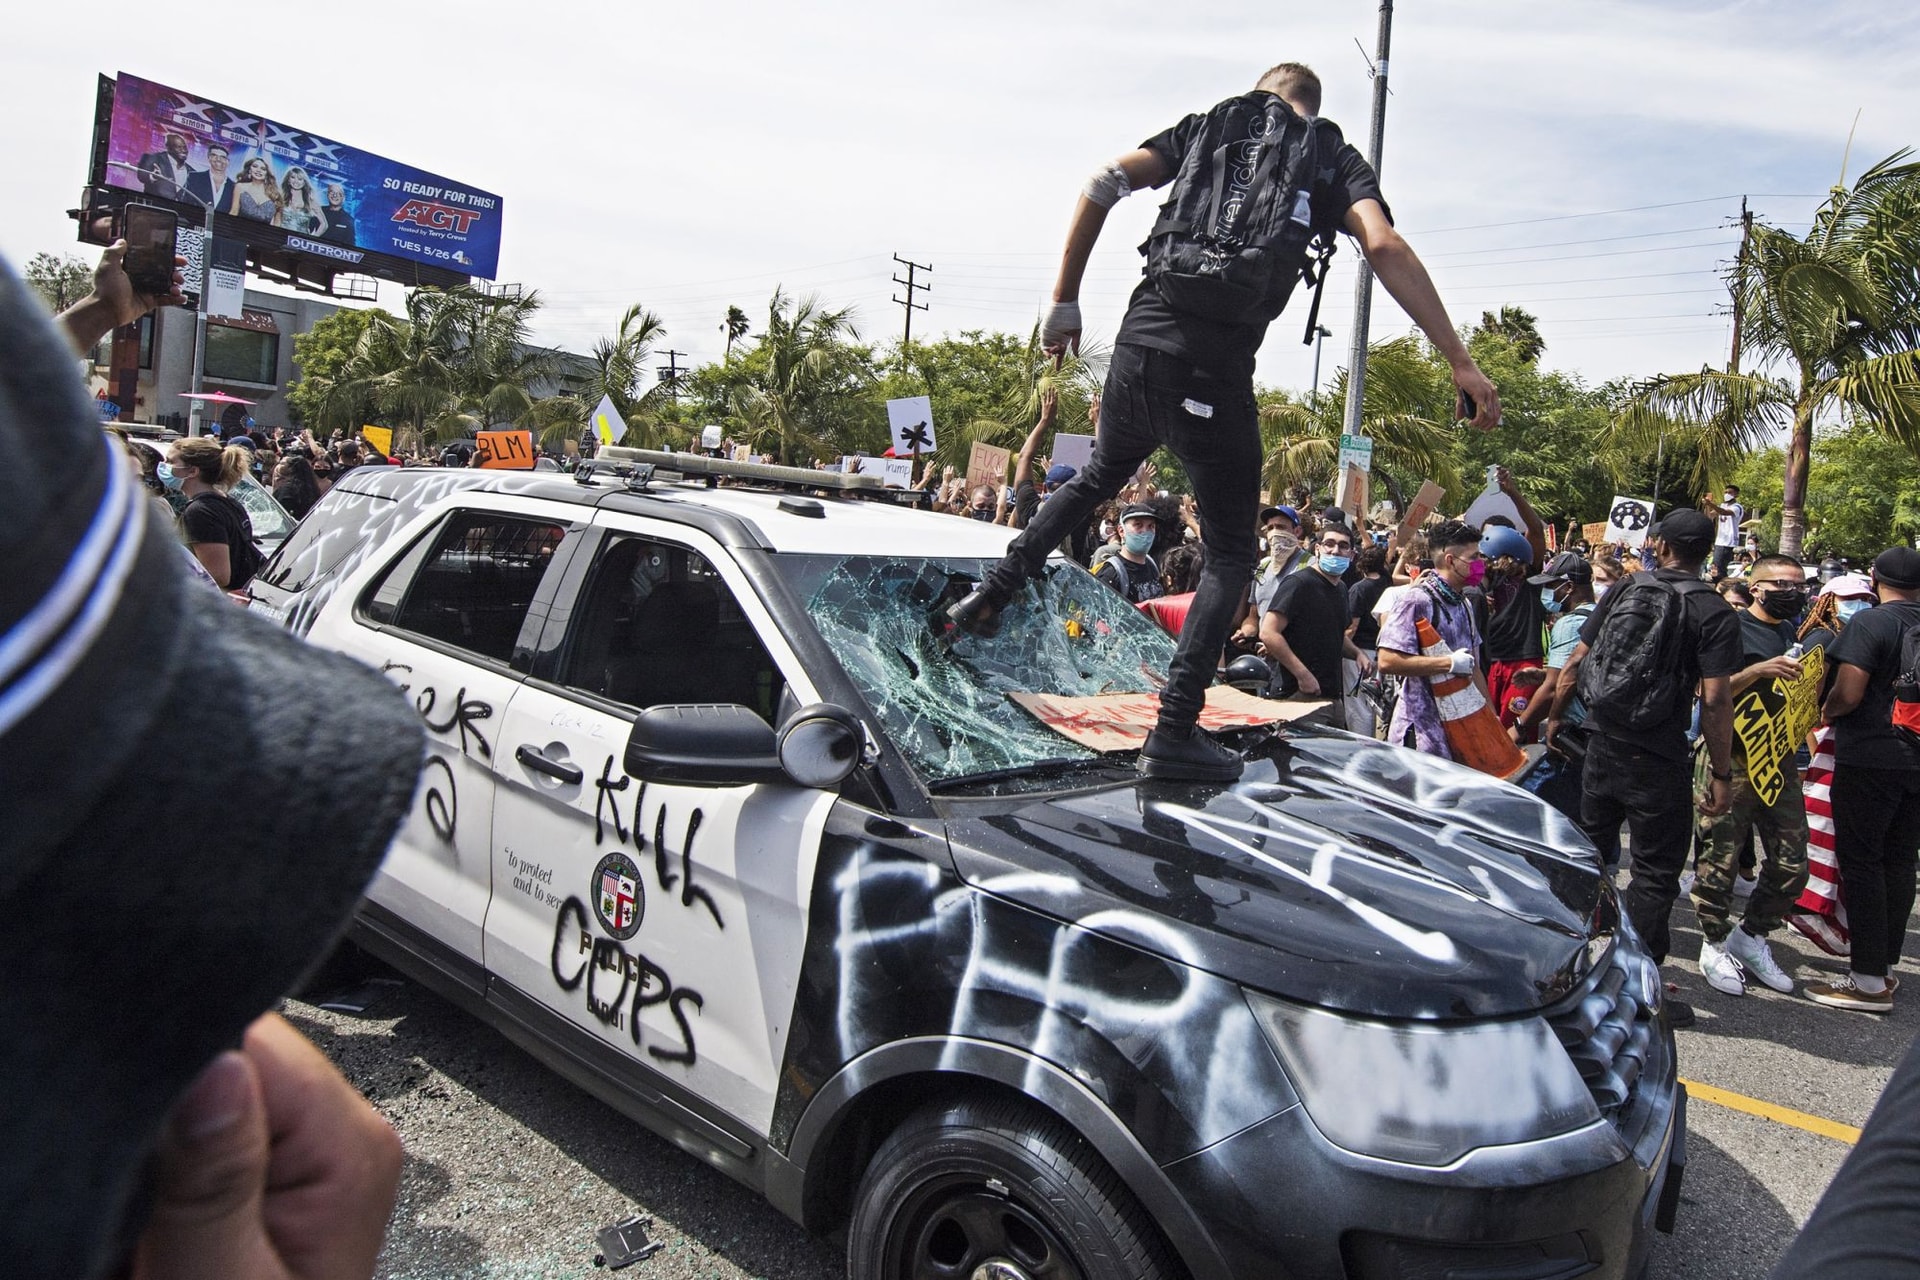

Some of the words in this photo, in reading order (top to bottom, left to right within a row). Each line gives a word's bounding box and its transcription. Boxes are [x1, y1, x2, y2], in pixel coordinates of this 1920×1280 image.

[181, 117, 206, 130] SIMON
[230, 132, 249, 143] SOFIA
[383, 177, 400, 190] SO
[402, 181, 442, 198] READY
[443, 190, 466, 203] FOR
[468, 194, 495, 209] THIS!
[391, 199, 481, 234] AGT
[398, 226, 419, 235] Hosted
[428, 229, 445, 239] Terry
[446, 232, 467, 242] Crews
[290, 237, 360, 262] OUTFRONT
[391, 237, 421, 252] TUES
[423, 246, 450, 260] 5/26
[478, 435, 526, 461] BLM
[1342, 435, 1350, 445] 2
[886, 460, 910, 478] Trump
[1772, 707, 1789, 758] LIVES
[1734, 693, 1781, 804] MATTER
[596, 754, 724, 931] KILL
[519, 859, 552, 885] protect
[513, 876, 532, 896] and
[534, 883, 544, 902] to
[552, 895, 704, 1065] COPS
